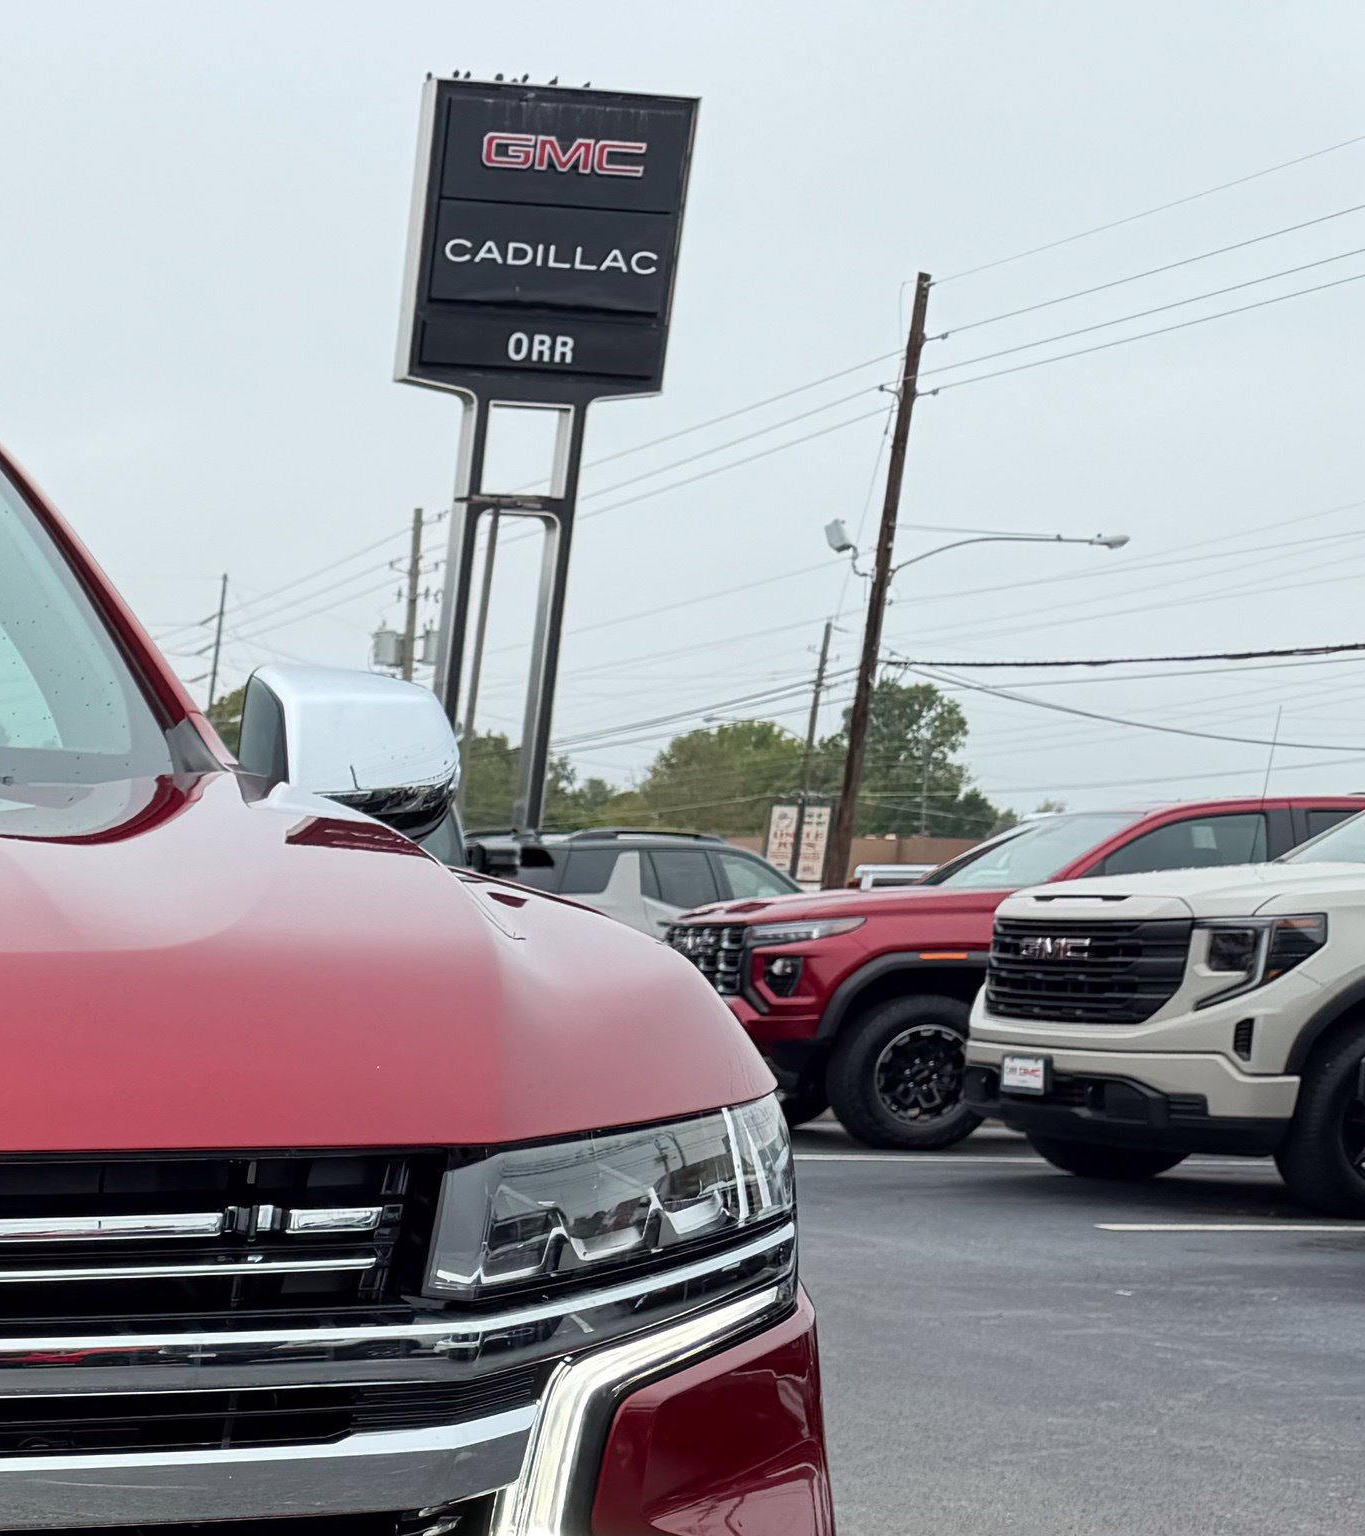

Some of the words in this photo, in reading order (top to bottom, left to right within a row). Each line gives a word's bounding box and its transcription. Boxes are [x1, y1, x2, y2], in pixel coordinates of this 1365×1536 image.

[481, 131, 648, 177] GMC
[444, 238, 658, 275] CADILLAC
[507, 331, 574, 364] ORR
